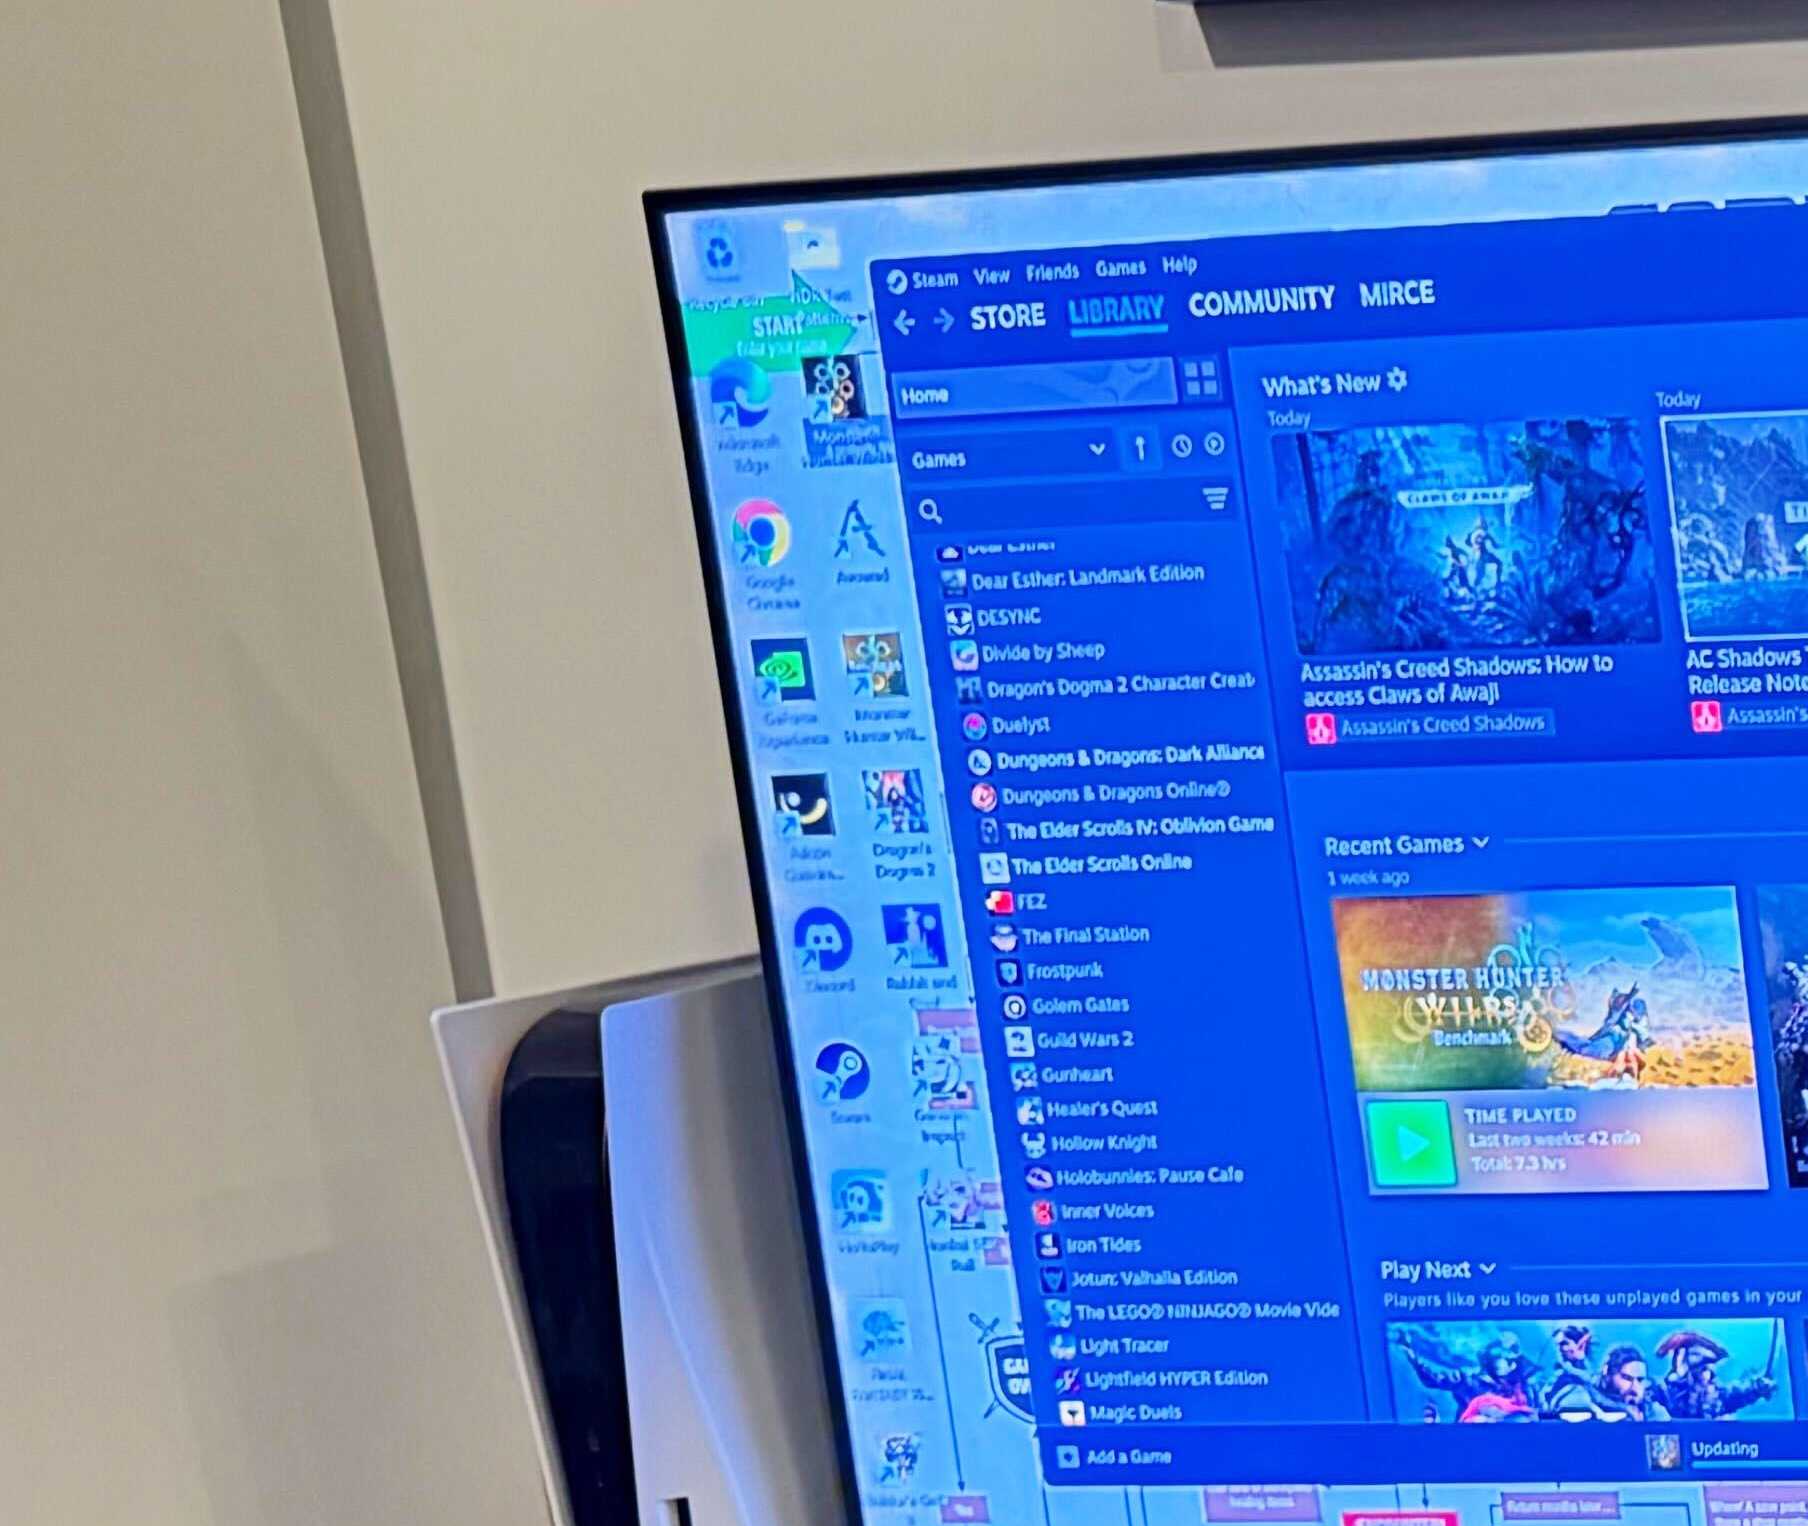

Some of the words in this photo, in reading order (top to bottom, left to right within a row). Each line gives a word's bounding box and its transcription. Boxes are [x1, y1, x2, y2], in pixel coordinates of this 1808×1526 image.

[913, 269, 958, 288] Steam
[973, 267, 1010, 285] View
[1026, 263, 1080, 281] Friends
[1096, 259, 1146, 278] Games
[1163, 256, 1198, 275] Help
[970, 303, 1046, 330] STORE
[1069, 295, 1164, 324] LIBRARY
[1188, 286, 1335, 318] COMMUNITY
[1359, 280, 1436, 307] MIRCE
[902, 386, 949, 404] Home
[1262, 376, 1332, 397] What's
[1337, 374, 1381, 393] New
[1656, 391, 1701, 408] Today
[1267, 409, 1311, 429] Today
[912, 451, 966, 469] Games
[977, 609, 1041, 626] DESYNC
[982, 646, 1030, 662] Divide
[1034, 644, 1052, 661] by
[1056, 642, 1105, 660] Sheep
[1301, 661, 1392, 682] Assassin's
[1396, 659, 1449, 678] Creed
[1455, 656, 1542, 677] Shadows:
[1546, 657, 1586, 675] How
[1592, 657, 1613, 673] to
[1689, 674, 1761, 695] Release
[1325, 837, 1392, 856] Recent
[1396, 835, 1463, 853] Games
[1012, 858, 1042, 875] The
[1045, 857, 1084, 874] Elder
[1088, 856, 1138, 872] Scrolls
[1141, 853, 1192, 871] Online
[1018, 893, 1047, 909] FEZ
[1027, 962, 1104, 980] Frostpunk
[1362, 968, 1467, 991] MONSTER
[1475, 967, 1562, 989] HUNTER
[1381, 1261, 1420, 1281] Play
[1426, 1261, 1471, 1279] Next
[1385, 1293, 1441, 1309] Players
[1447, 1291, 1476, 1307] like
[1480, 1292, 1510, 1308] you
[1515, 1292, 1550, 1307] love
[1555, 1290, 1600, 1307] these
[1606, 1290, 1680, 1307] unplayed
[1686, 1290, 1740, 1306] games
[1745, 1289, 1761, 1303] in
[1766, 1290, 1802, 1306] your
[1691, 1441, 1759, 1458] Updating
